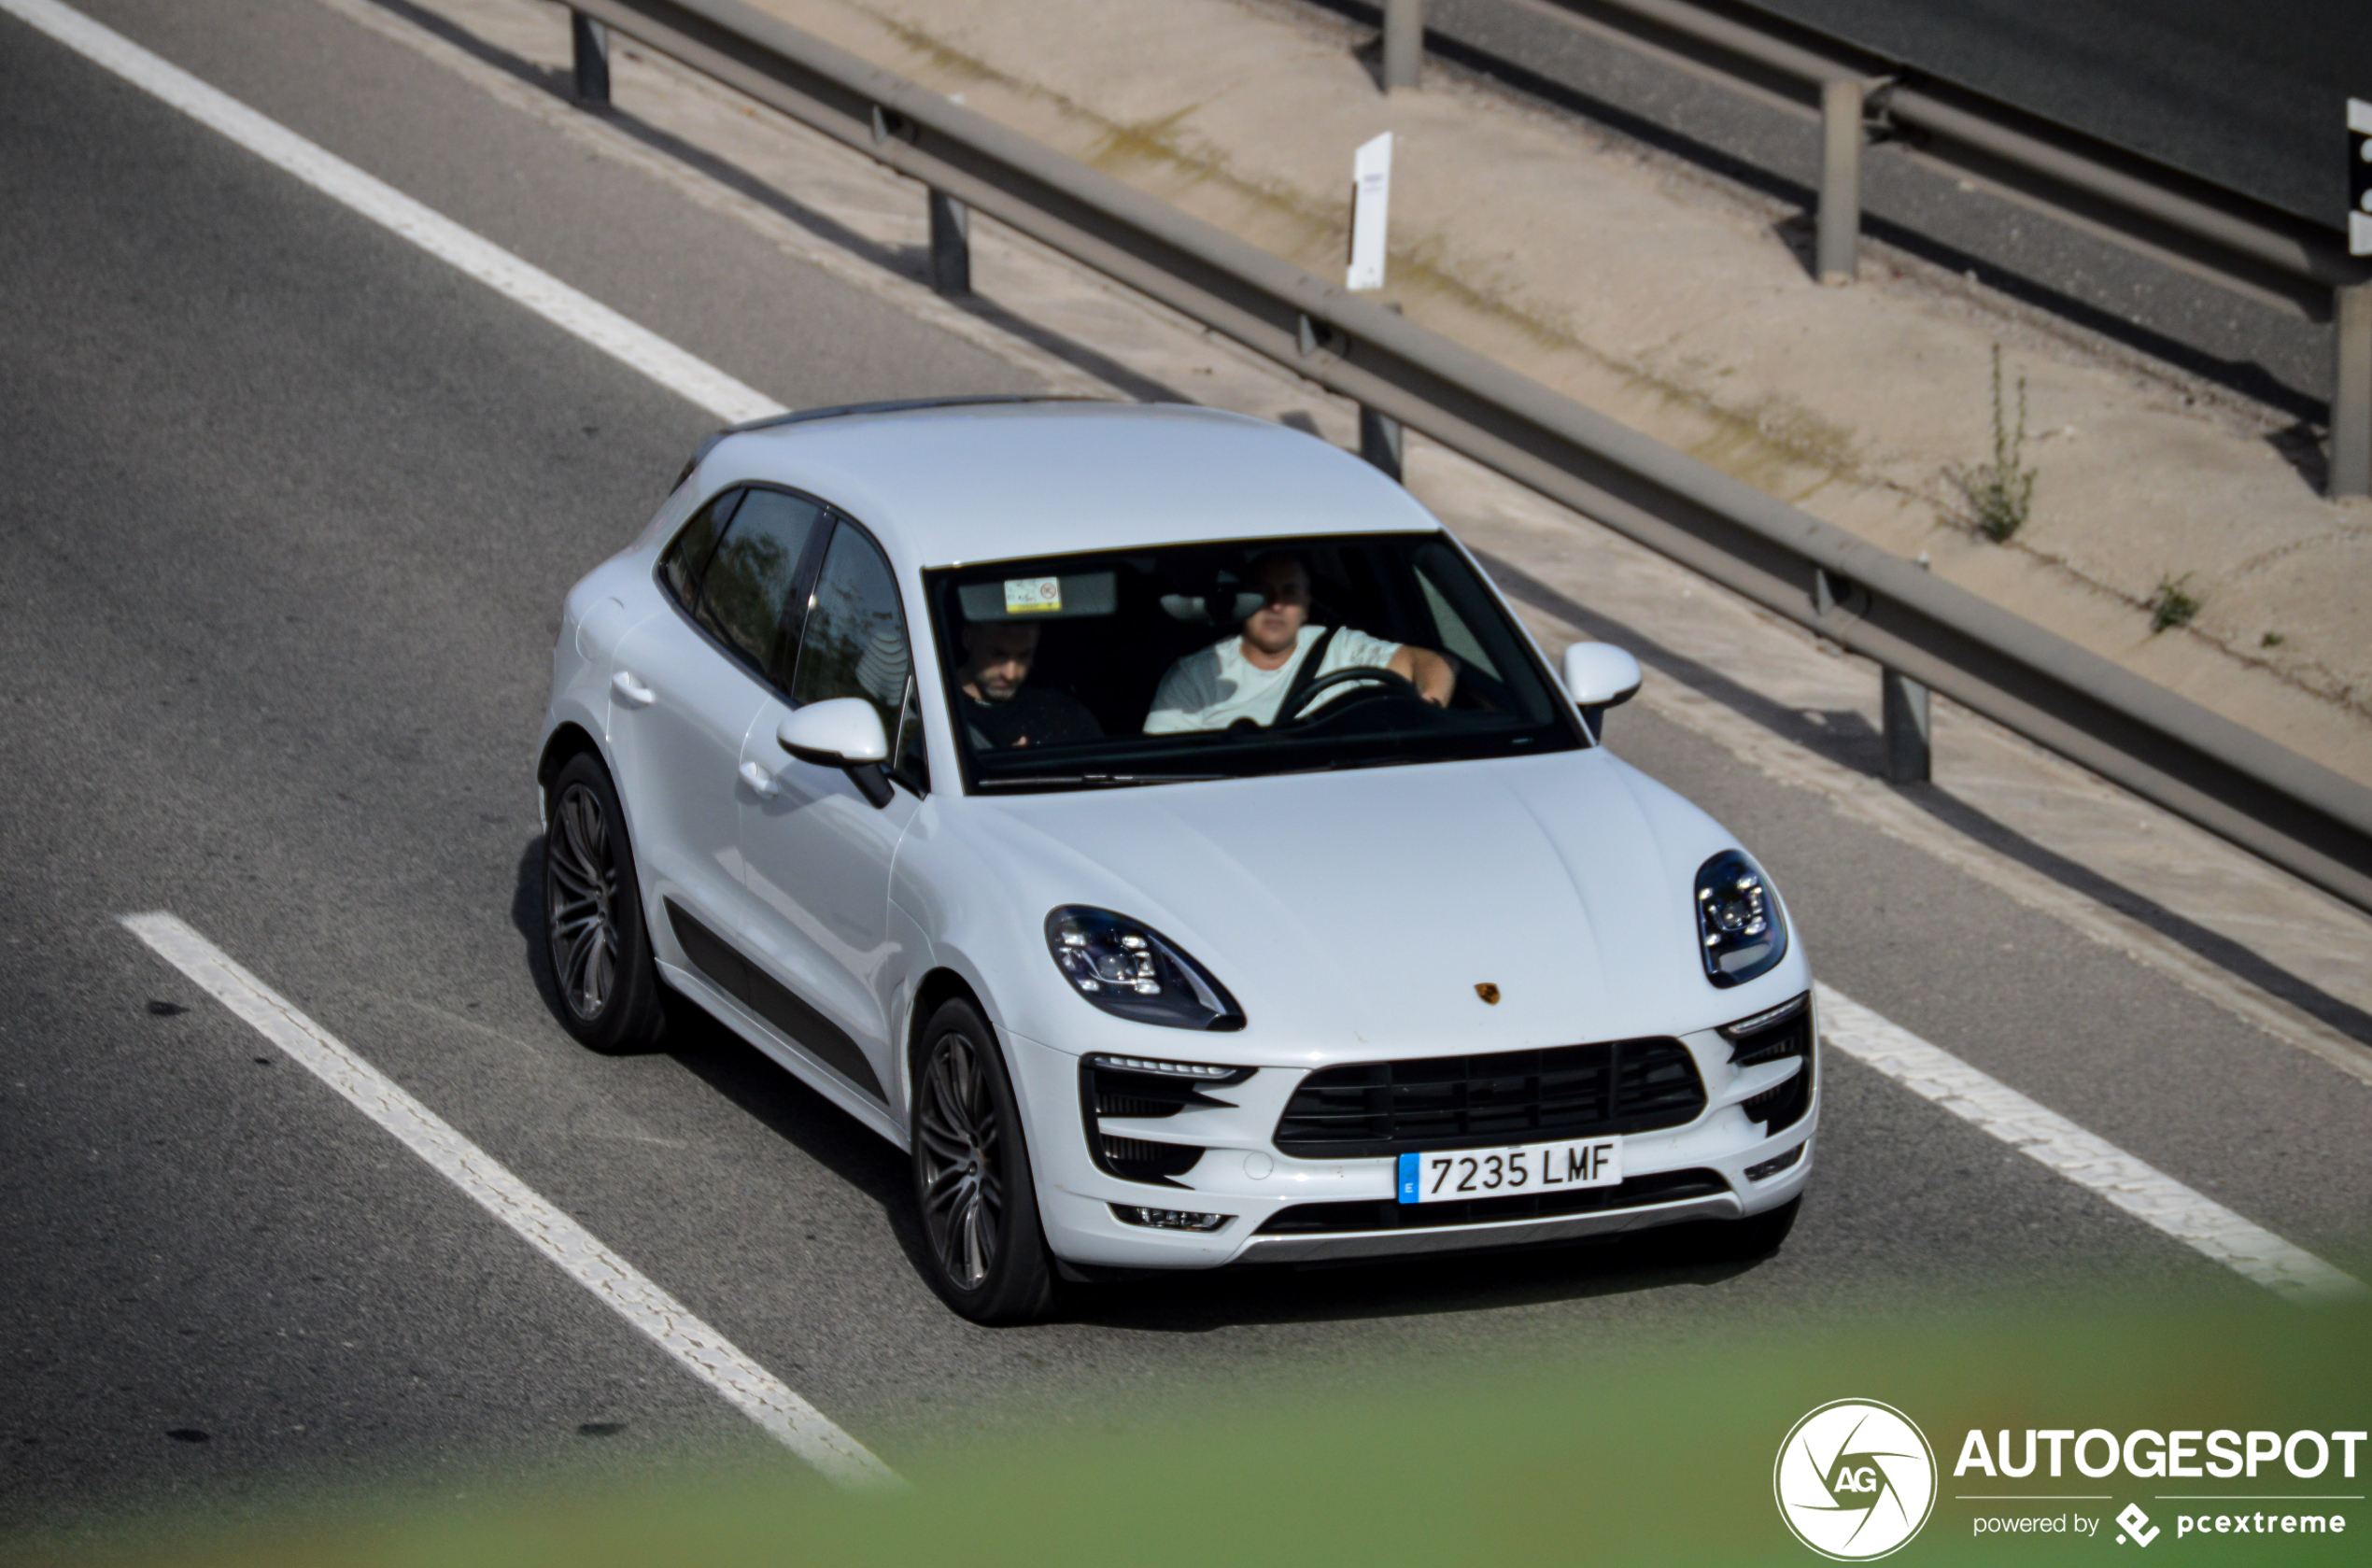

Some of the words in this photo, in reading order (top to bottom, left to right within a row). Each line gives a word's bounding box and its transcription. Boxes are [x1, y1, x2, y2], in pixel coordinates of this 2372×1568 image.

[1431, 1152, 1528, 1194] 7235
[1543, 1143, 1614, 1185] LMF
[1405, 1182, 1414, 1194] E
